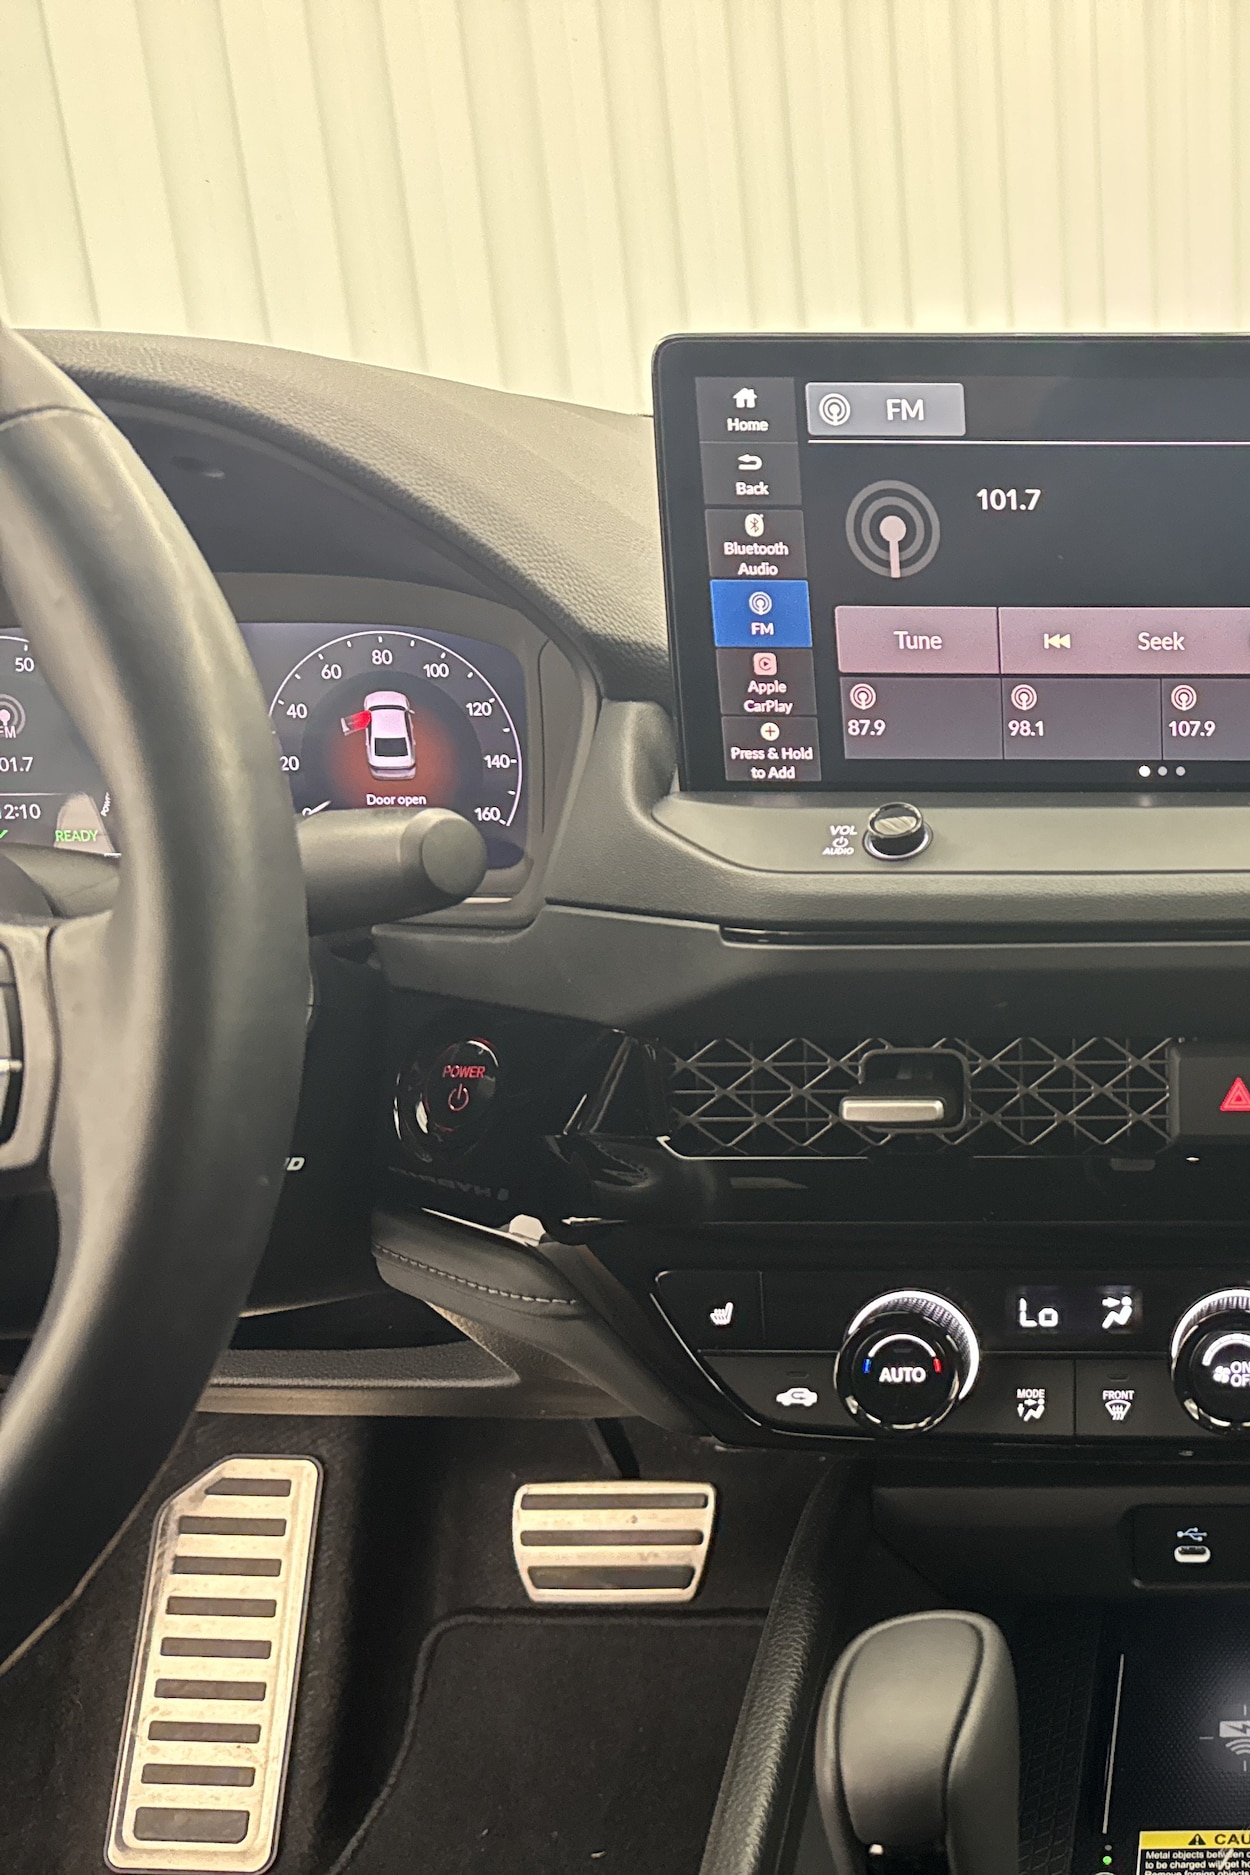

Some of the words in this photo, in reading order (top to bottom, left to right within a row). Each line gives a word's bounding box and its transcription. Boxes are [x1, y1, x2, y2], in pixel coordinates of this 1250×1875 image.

[886, 398, 925, 421] FM
[726, 417, 769, 432] Home
[735, 481, 770, 496] Back
[976, 488, 1041, 511] 101.7
[723, 541, 789, 556] Bluetooth
[737, 561, 779, 576] Audio
[750, 622, 775, 636] FM
[892, 630, 943, 650] Tune
[1137, 631, 1185, 651] Seek
[15, 657, 35, 672] 50
[371, 649, 393, 665] 80
[321, 663, 342, 680] 60
[423, 662, 450, 678] 100
[747, 679, 787, 696] Apple
[286, 703, 308, 719] 40
[465, 701, 493, 717] 120
[743, 699, 794, 715] CarPlay
[847, 719, 886, 736] 87.9
[1007, 719, 1044, 737] 98.1
[1168, 720, 1216, 737] 107.9
[730, 746, 766, 760] Press
[766, 747, 780, 760] &
[781, 746, 814, 760] Hold
[281, 755, 300, 771] 20
[482, 754, 511, 770] 140
[750, 766, 767, 780] to
[767, 765, 796, 780] Add
[365, 793, 397, 806] Door
[396, 795, 427, 807] open
[0, 803, 42, 821] 2:10
[473, 807, 501, 823] 160
[54, 829, 99, 843] READY
[829, 825, 858, 836] VOL
[822, 847, 855, 855] AUDIO
[442, 1065, 485, 1079] POWER
[878, 1366, 927, 1383] AUTO
[1016, 1388, 1046, 1399] MODE
[1102, 1389, 1135, 1401] FRONT
[1145, 1850, 1171, 1860] Metal
[1172, 1850, 1204, 1861] objects
[1145, 1861, 1154, 1870] to
[1155, 1861, 1168, 1870] be
[1169, 1860, 1207, 1871] charged
